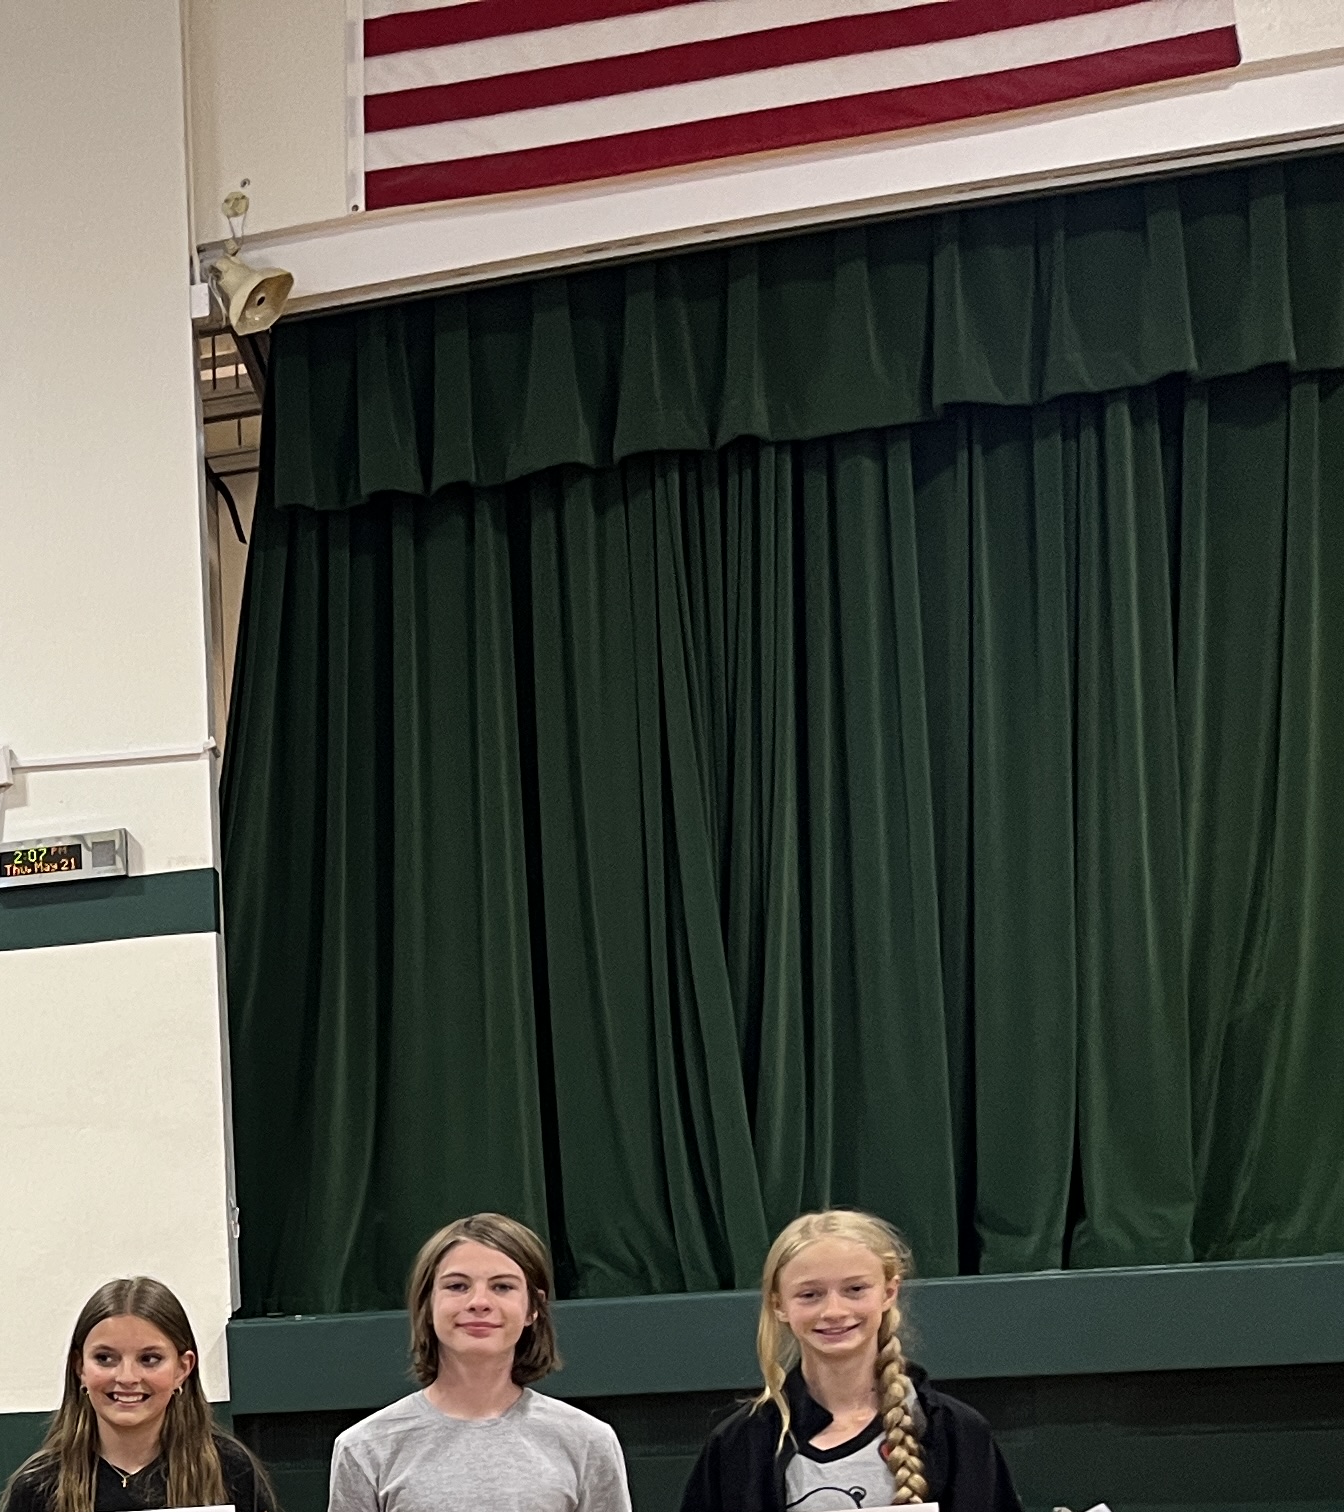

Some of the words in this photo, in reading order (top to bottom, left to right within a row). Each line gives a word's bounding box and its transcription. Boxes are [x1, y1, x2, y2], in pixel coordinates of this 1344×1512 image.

[14, 847, 47, 864] 2:07
[34, 861, 58, 873] May
[60, 858, 76, 870] 21
